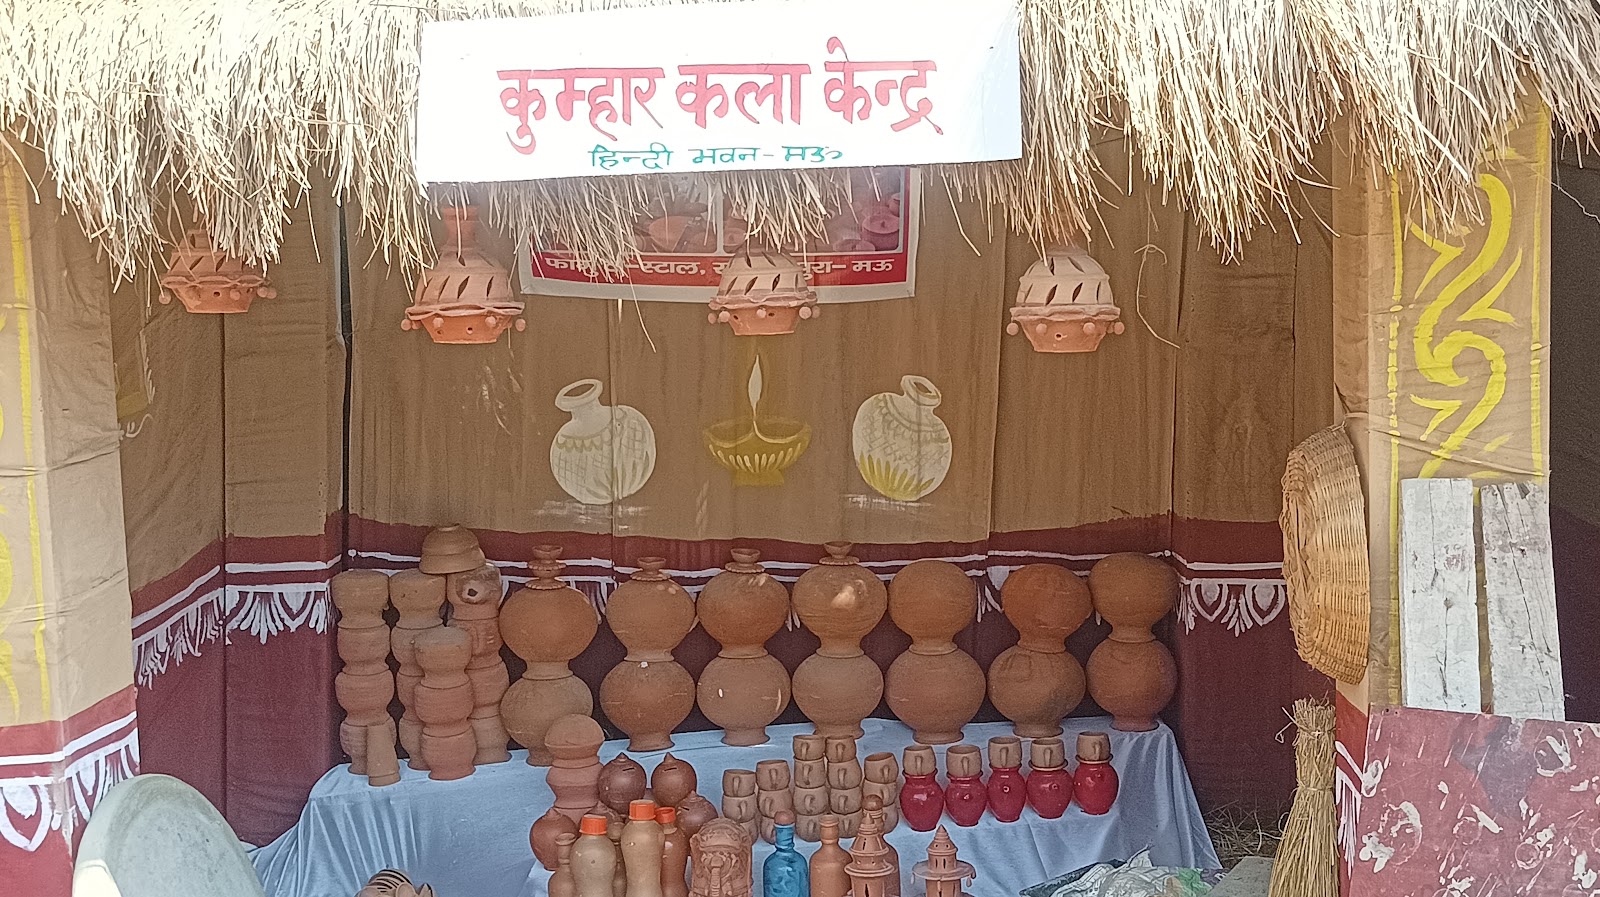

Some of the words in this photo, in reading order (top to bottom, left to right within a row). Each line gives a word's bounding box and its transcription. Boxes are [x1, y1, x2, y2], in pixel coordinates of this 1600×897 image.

[497, 67, 666, 155] कुम्हार
[676, 64, 811, 129] कला
[824, 36, 944, 135] केन्द्र
[588, 142, 673, 170] हिन्दी
[782, 145, 843, 163] मऊ
[852, 258, 895, 273] मऊ
